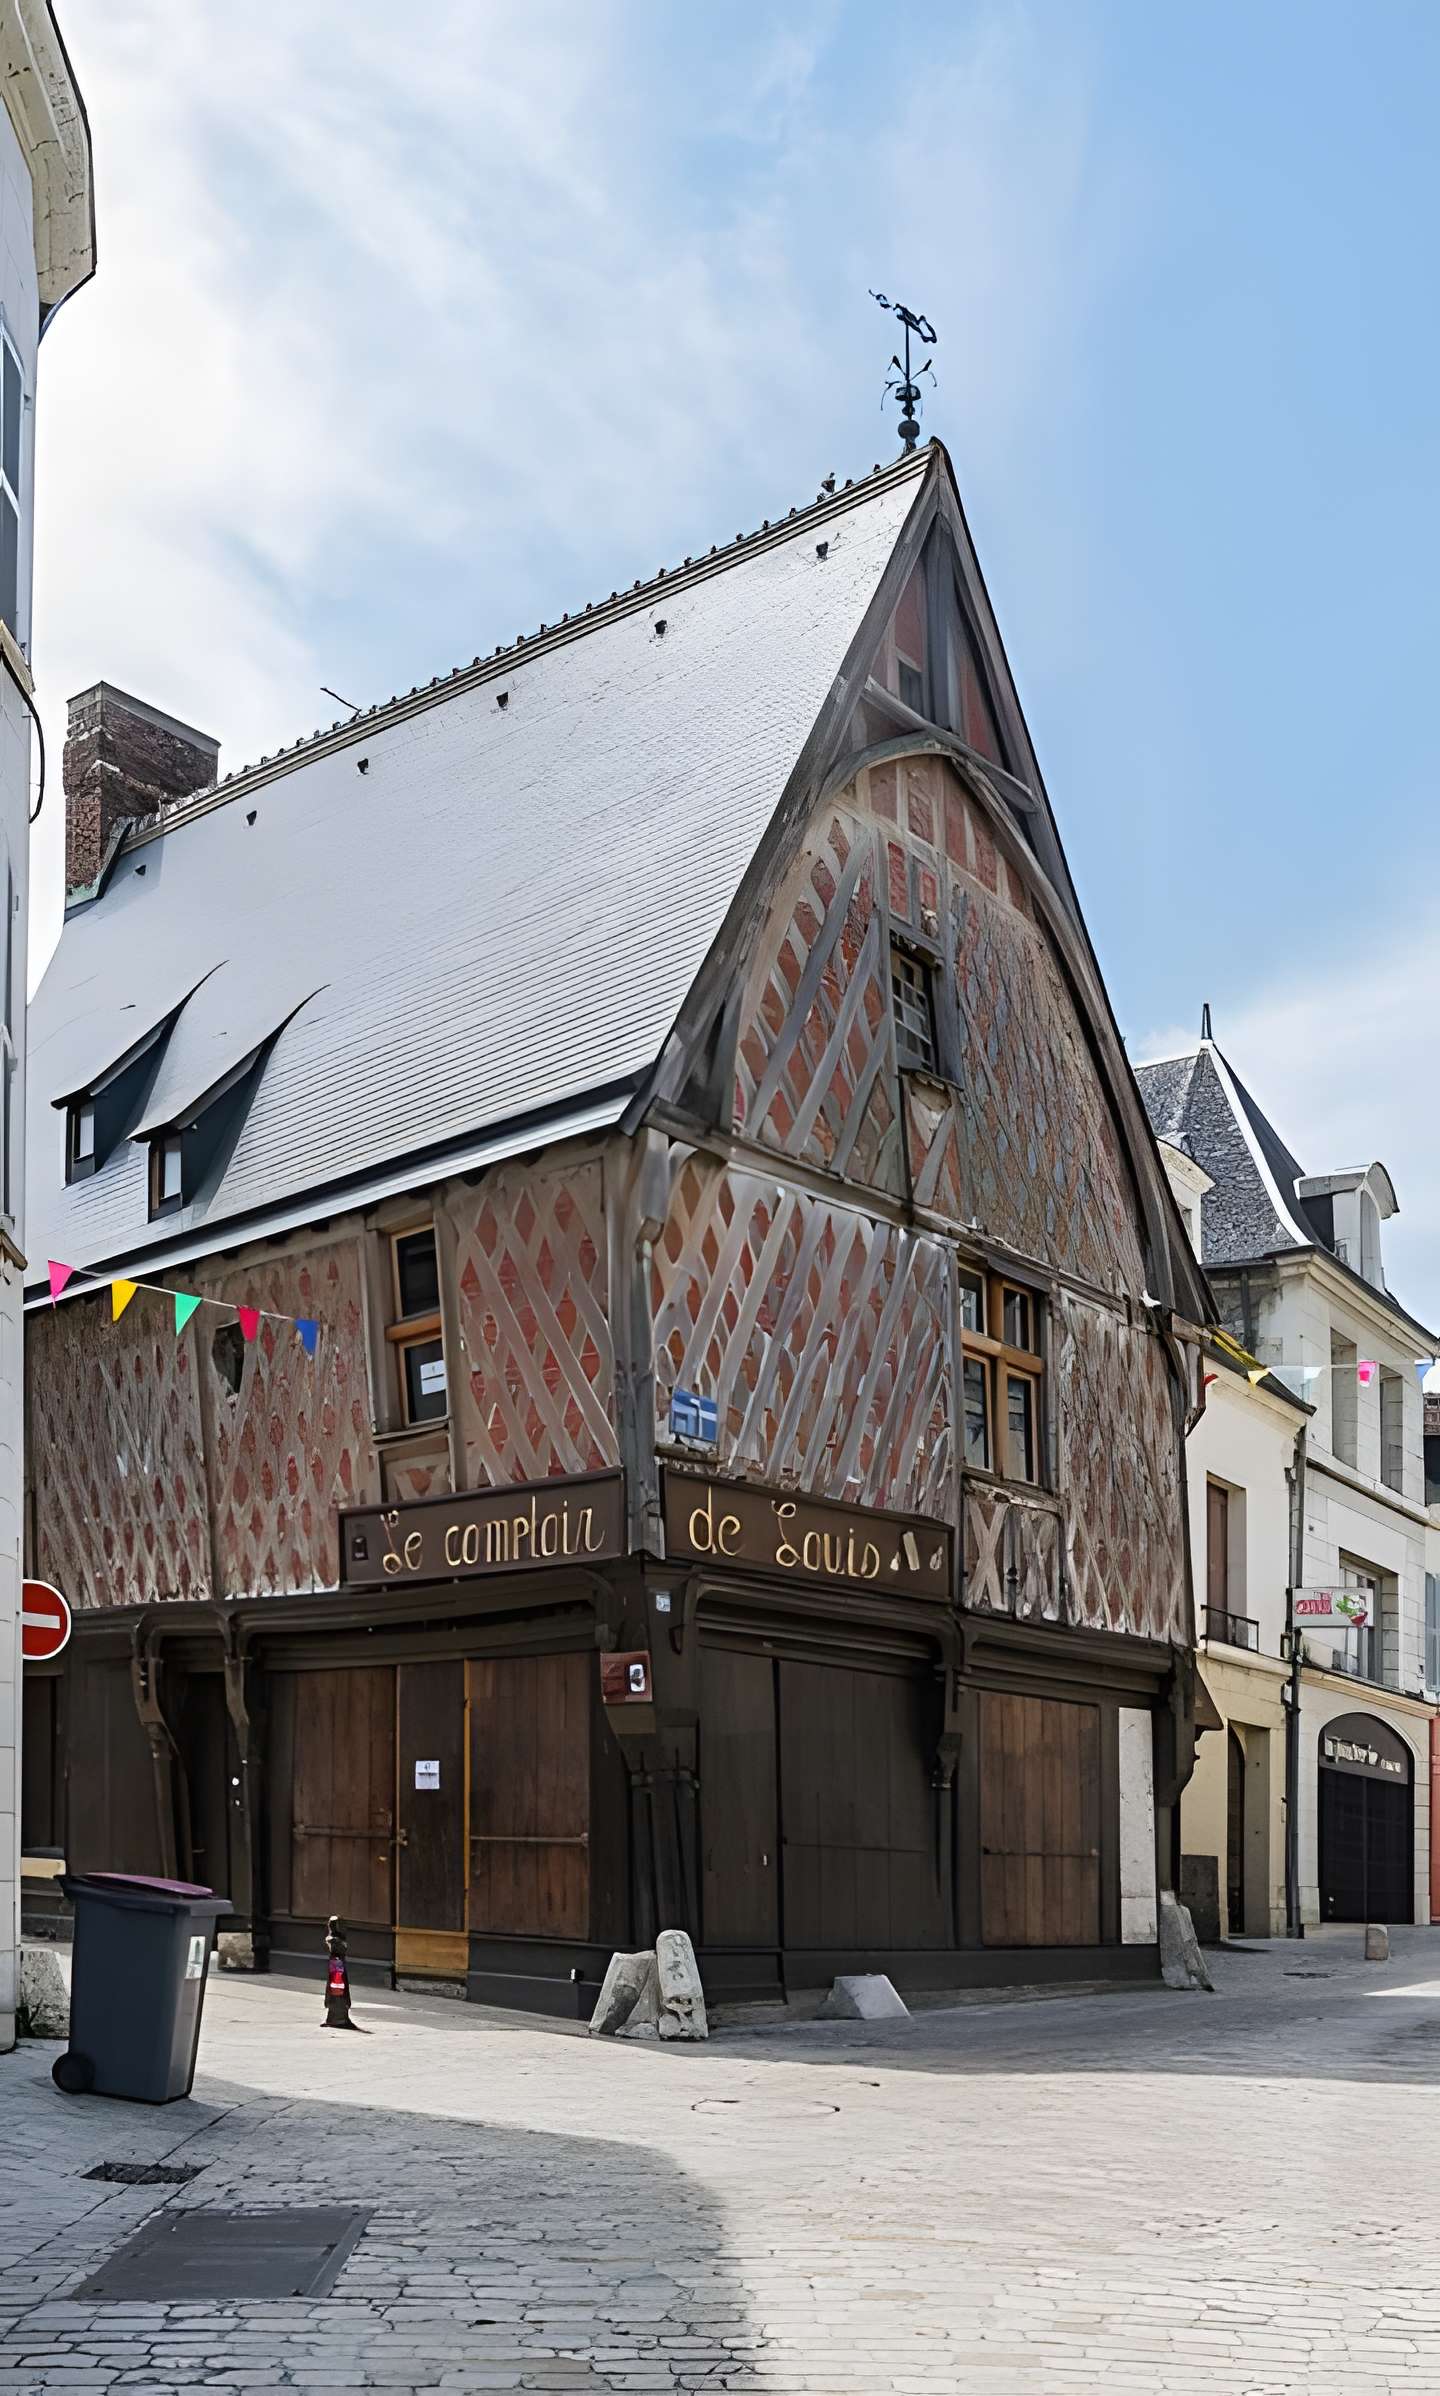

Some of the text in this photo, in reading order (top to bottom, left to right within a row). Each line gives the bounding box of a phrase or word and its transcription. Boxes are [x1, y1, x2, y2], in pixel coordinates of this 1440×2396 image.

[380, 1509, 424, 1575] Le
[688, 1485, 746, 1557] de
[771, 1500, 881, 1579] Louis
